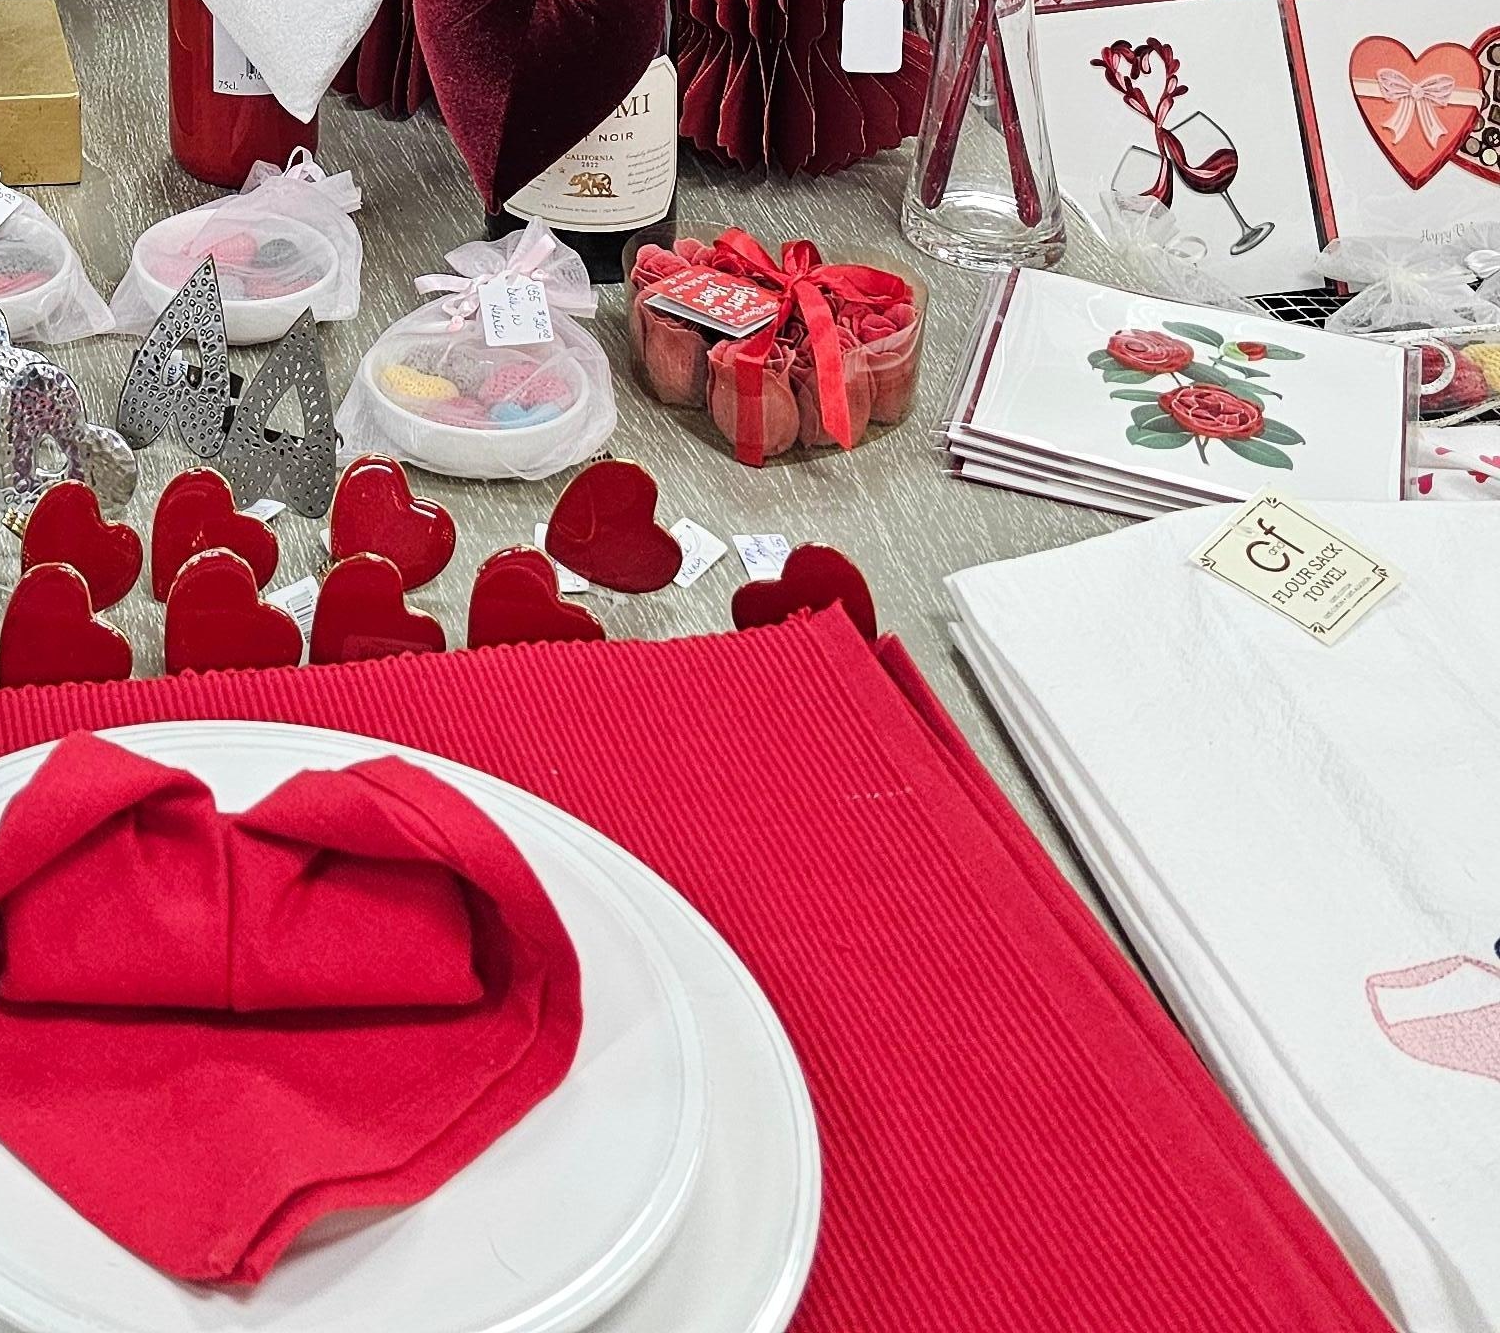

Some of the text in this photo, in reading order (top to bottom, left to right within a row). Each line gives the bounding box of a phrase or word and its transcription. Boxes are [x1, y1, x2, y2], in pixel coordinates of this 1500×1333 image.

[598, 132, 634, 142] NOIR
[565, 153, 614, 161] CALIFORNIA
[1271, 567, 1316, 605] FLOUR
[1308, 542, 1343, 576] SACK
[1303, 566, 1347, 602] TOWEL
